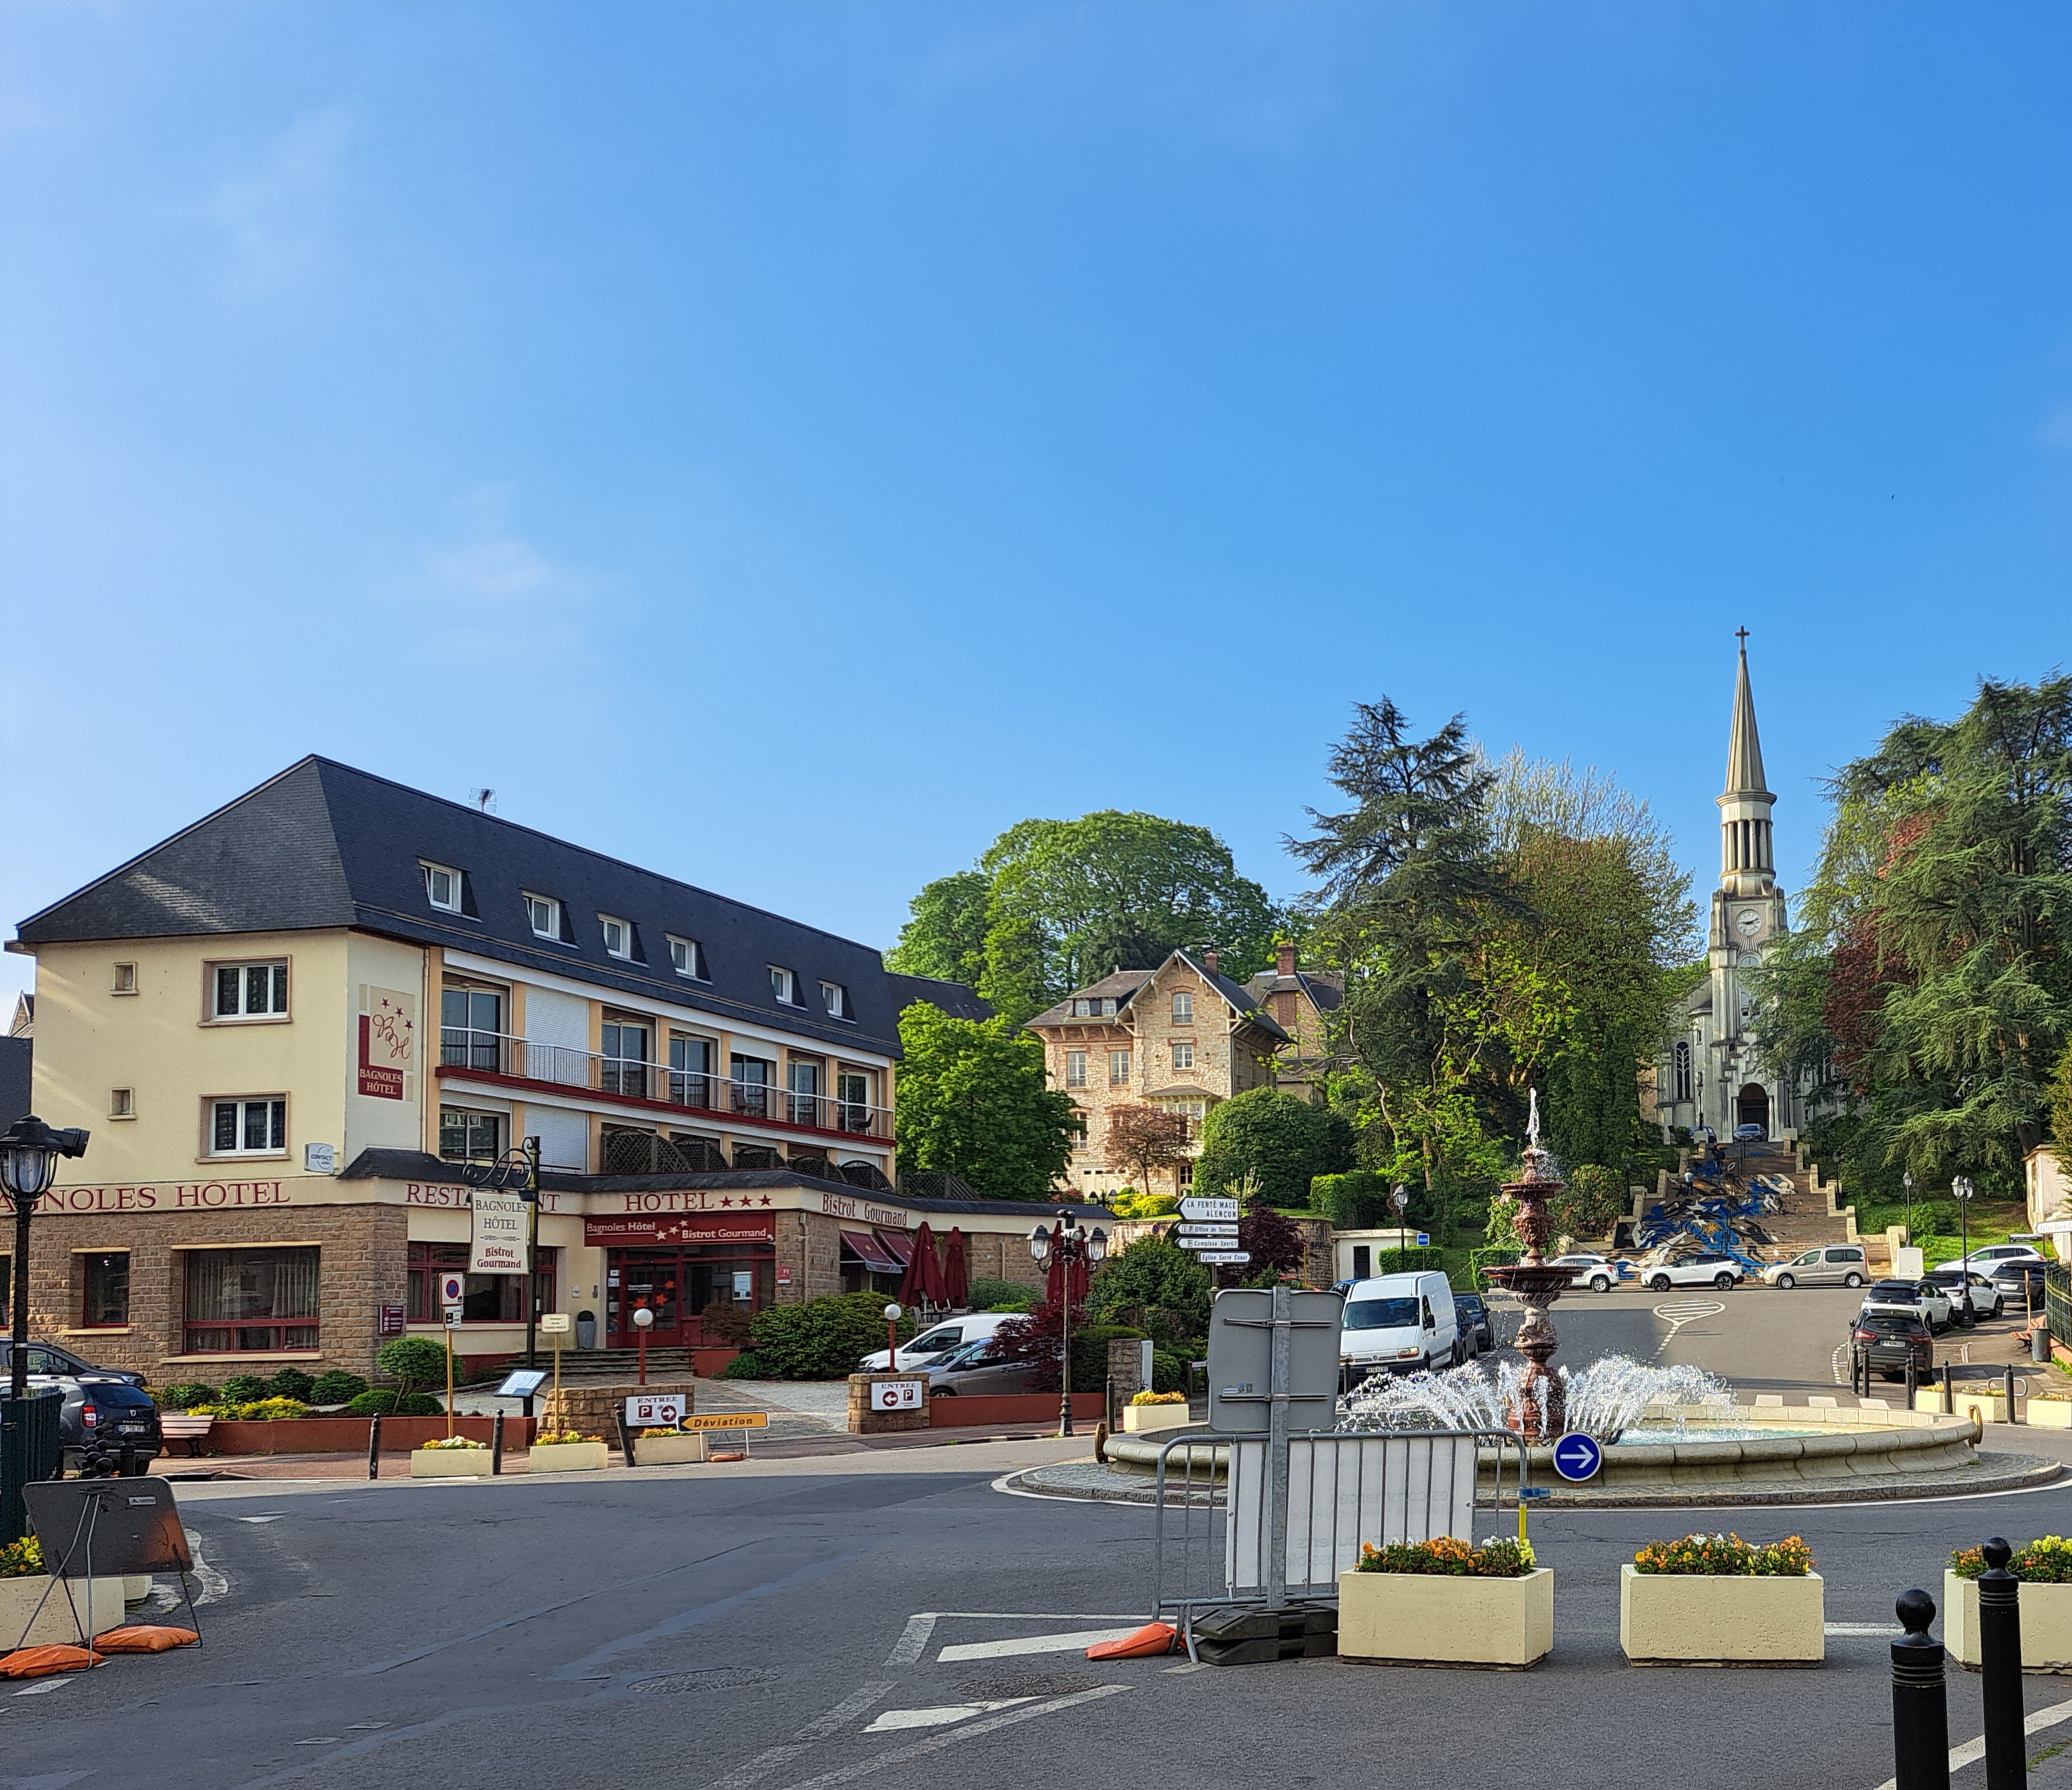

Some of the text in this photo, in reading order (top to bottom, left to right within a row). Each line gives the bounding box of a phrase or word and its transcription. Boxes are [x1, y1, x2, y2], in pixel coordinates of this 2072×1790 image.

[360, 1068, 402, 1084] BAGNOLES
[366, 1081, 397, 1094] HÔTEL
[174, 1180, 291, 1207] HÔTEL
[405, 1183, 561, 1212] RESTNT
[475, 1200, 528, 1213] BAGNOLES
[624, 1190, 715, 1212] HÔTEL
[1219, 1200, 1236, 1209] MACÉ
[822, 1194, 908, 1226] Bistrot Gourmand
[1206, 1210, 1236, 1218] ALENÇON
[483, 1216, 518, 1230] HÔTEL
[586, 1222, 655, 1234] Bagnoles Hôtel
[681, 1228, 767, 1239] Bistrot Gourmand
[485, 1247, 514, 1259] Bistrot
[477, 1259, 522, 1269] Gourmand
[694, 1418, 753, 1428] Déviation
